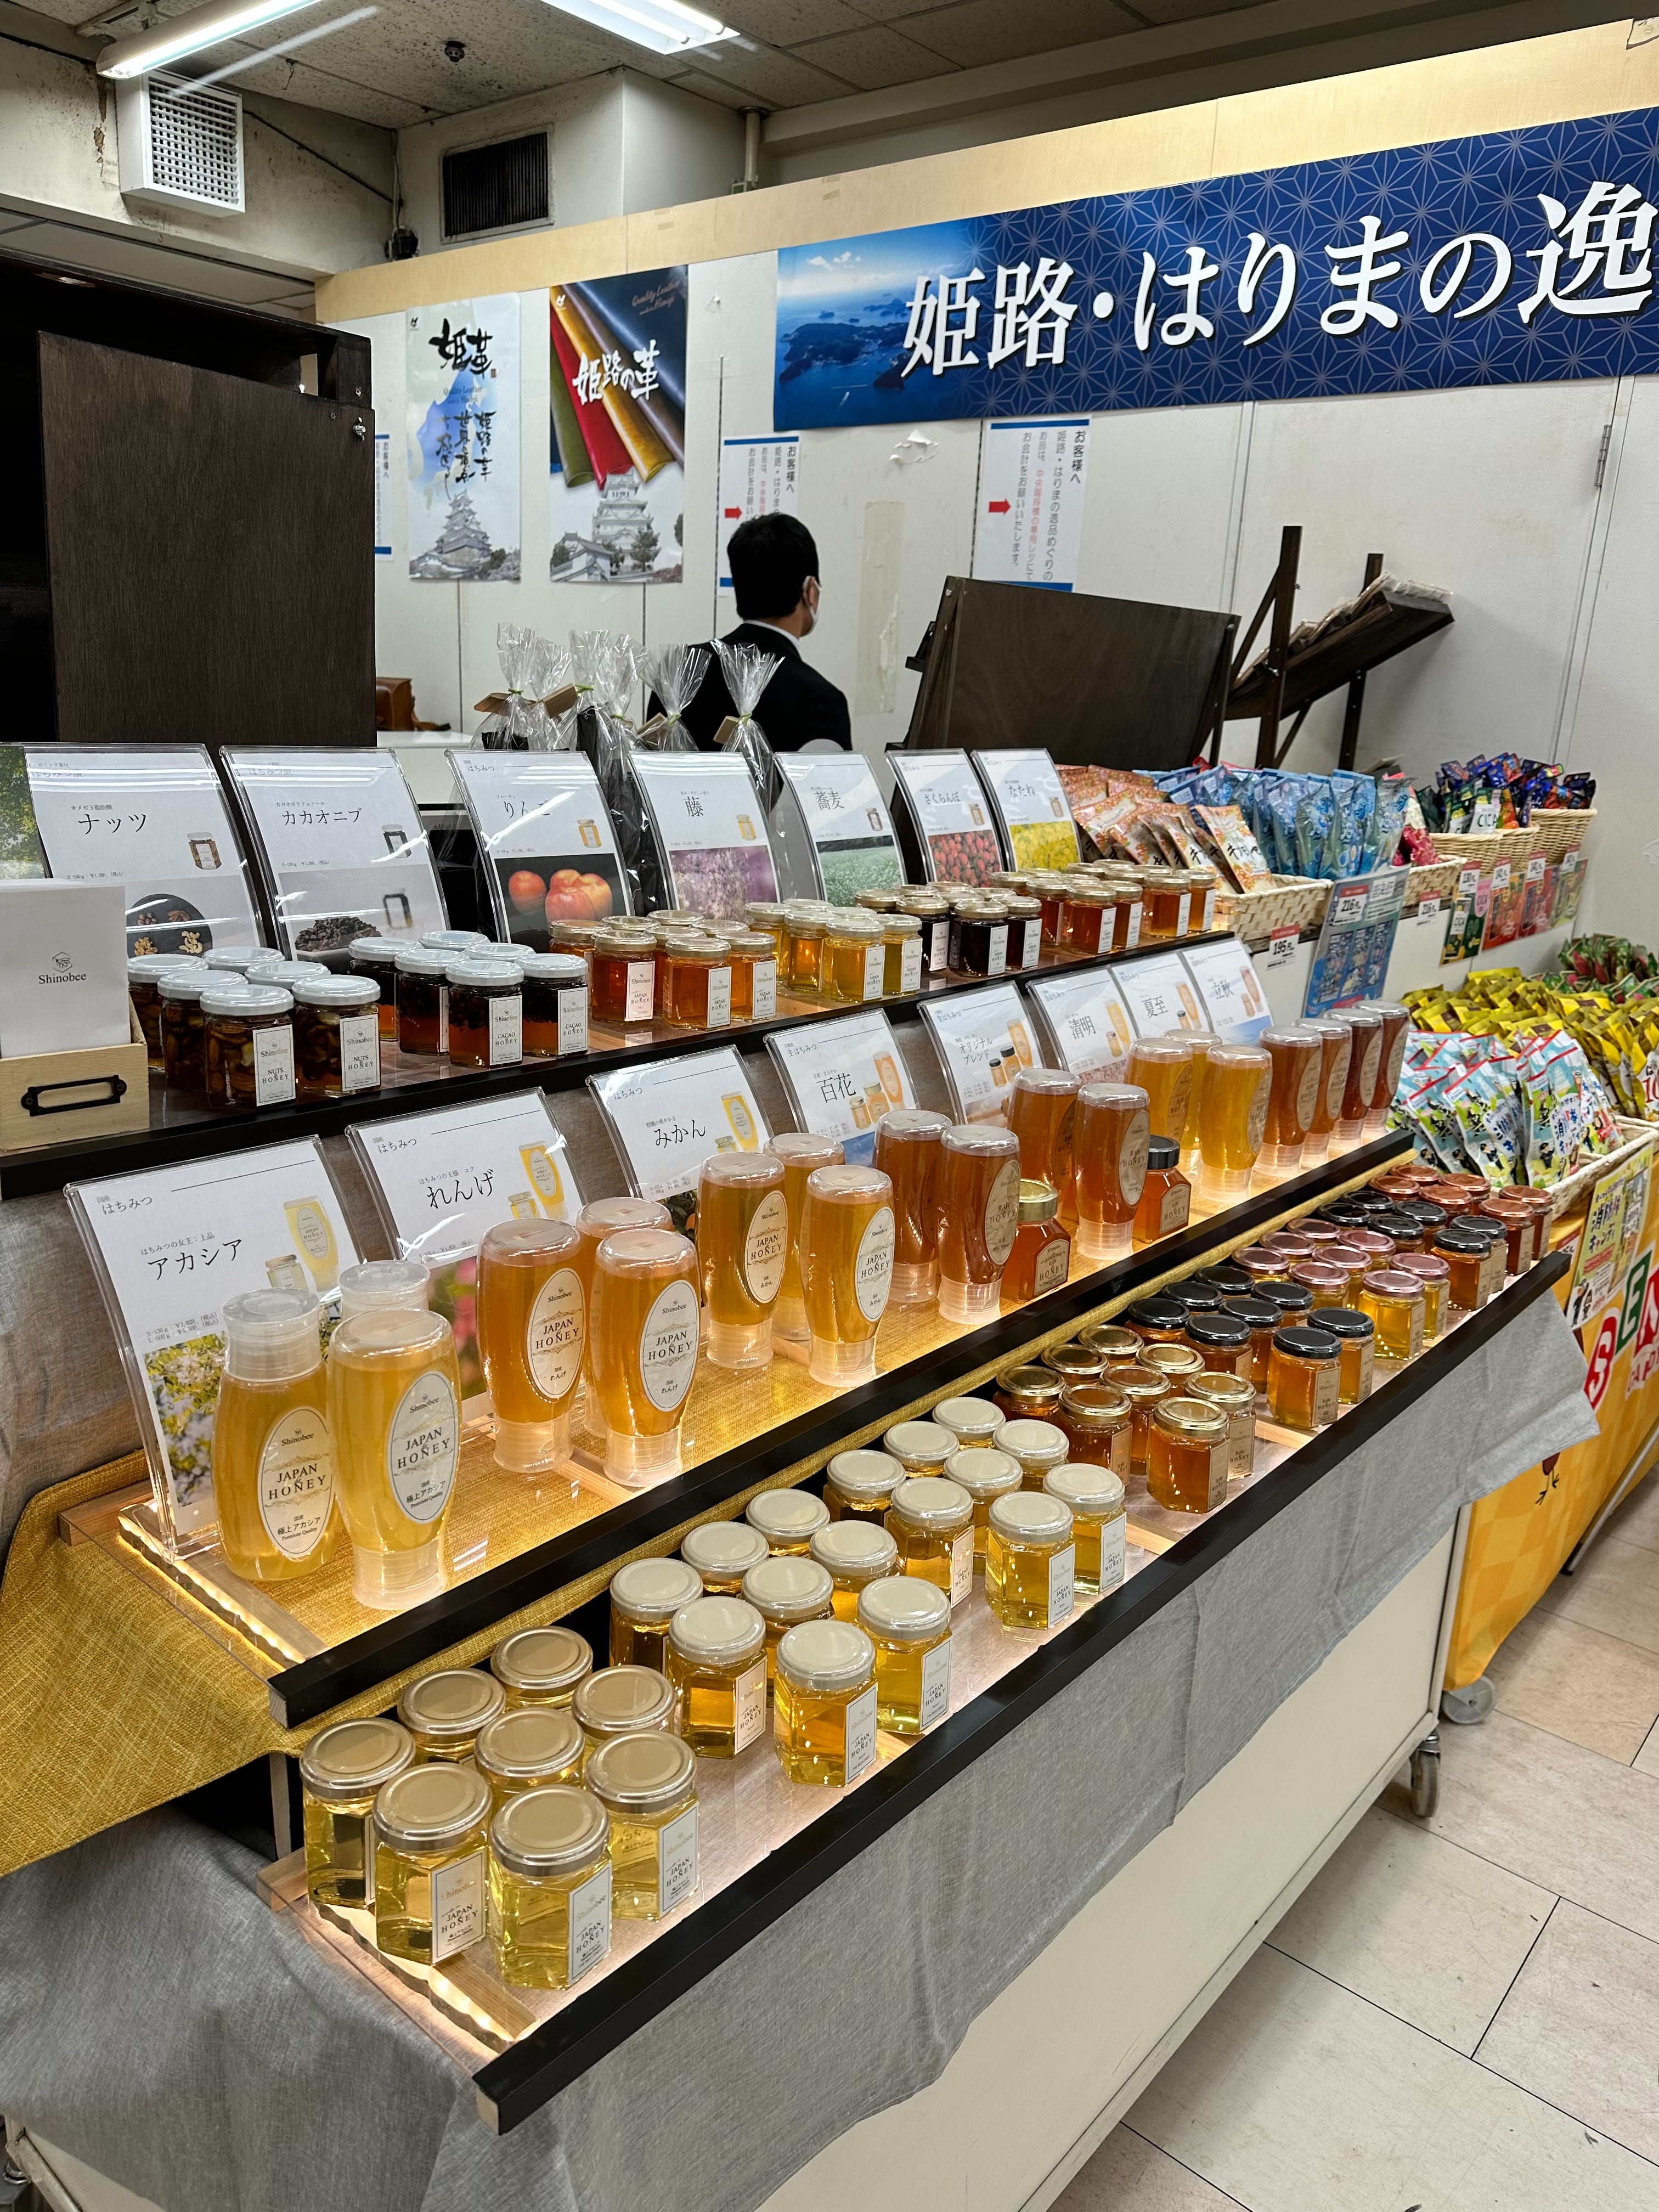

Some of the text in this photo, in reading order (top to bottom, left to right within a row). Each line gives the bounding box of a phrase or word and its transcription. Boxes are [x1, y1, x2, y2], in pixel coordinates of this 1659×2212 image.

[900, 179, 1657, 380] 姫路・はりまの逸
[572, 338, 661, 405] 姫路の革
[1070, 430, 1086, 484] お客様へ
[786, 446, 796, 493] お客様へ
[684, 796, 704, 817] 藤
[814, 791, 845, 811] 蕎麦
[924, 791, 961, 805] さくらんぼ
[77, 812, 147, 835] ナッツ
[281, 807, 362, 826] カカオニブ
[1341, 899, 1356, 912] 216
[1273, 940, 1288, 955] 195
[38, 972, 87, 985] Shinobee
[1212, 979, 1235, 999] 立秋
[1142, 996, 1169, 1019] 夏至
[1069, 1015, 1097, 1040] 清明
[495, 1038, 518, 1046] HONEY
[787, 1045, 816, 1057] 生はちみつ
[959, 1037, 993, 1054] オリジナル
[348, 1061, 374, 1070] HONEY
[963, 1048, 990, 1065] ブレンド
[262, 1074, 290, 1084] HONEY
[267, 1067, 284, 1075] NUTS
[613, 1087, 643, 1101] はちみつ
[816, 1073, 856, 1103] 百花
[654, 1119, 706, 1149] みかん
[377, 1137, 417, 1154] はちみつ
[1130, 1148, 1142, 1156] RAW
[1123, 1156, 1146, 1167] HONEY
[426, 1169, 494, 1209] れんげ
[101, 1195, 154, 1215] はちみつ
[998, 1202, 1010, 1211] RAW
[1164, 1207, 1186, 1220] HONEY
[990, 1210, 1016, 1223] HONEY
[756, 1233, 779, 1248] JAPAN
[147, 1238, 242, 1281] アカシア
[751, 1243, 783, 1260] HONEY
[866, 1251, 887, 1266] JAPAN
[861, 1260, 890, 1279] HONEY
[1039, 1265, 1064, 1281] HONEY
[548, 1290, 573, 1303] Shinobee
[662, 1303, 687, 1315] Shinobee
[543, 1317, 574, 1335] JAPAN
[535, 1328, 580, 1350] HONEY
[656, 1330, 687, 1346] JAPAN
[648, 1340, 693, 1361] HONEY
[550, 1372, 567, 1381] れんげ
[661, 1384, 679, 1394] れんげ
[410, 1397, 439, 1414] Shinobee
[281, 1432, 314, 1446] Shinobee
[405, 1426, 443, 1451] JAPAN
[397, 1437, 450, 1469] HONEY
[1230, 1454, 1249, 1463] HONEY
[277, 1463, 317, 1483] JAPAN
[268, 1475, 326, 1500] HONEY
[407, 1481, 445, 1503] 極上アカシア
[278, 1516, 321, 1535] 極上アカシア
[1105, 1558, 1122, 1572] HONEY
[1053, 1591, 1071, 1605] HONEY
[926, 1688, 946, 1707] HONEY
[929, 1682, 944, 1697] JAPAN
[741, 1708, 761, 1729] HONEY
[851, 1736, 873, 1758] HONEY
[855, 1731, 870, 1748] JAPAN
[667, 1862, 693, 1888] HONEY
[670, 1857, 690, 1876] JAPAN
[441, 1910, 479, 1933] HONEY
[447, 1904, 473, 1922] JAPAN
[580, 1919, 602, 1941] JAPAN
[577, 1926, 605, 1954] HONEY
